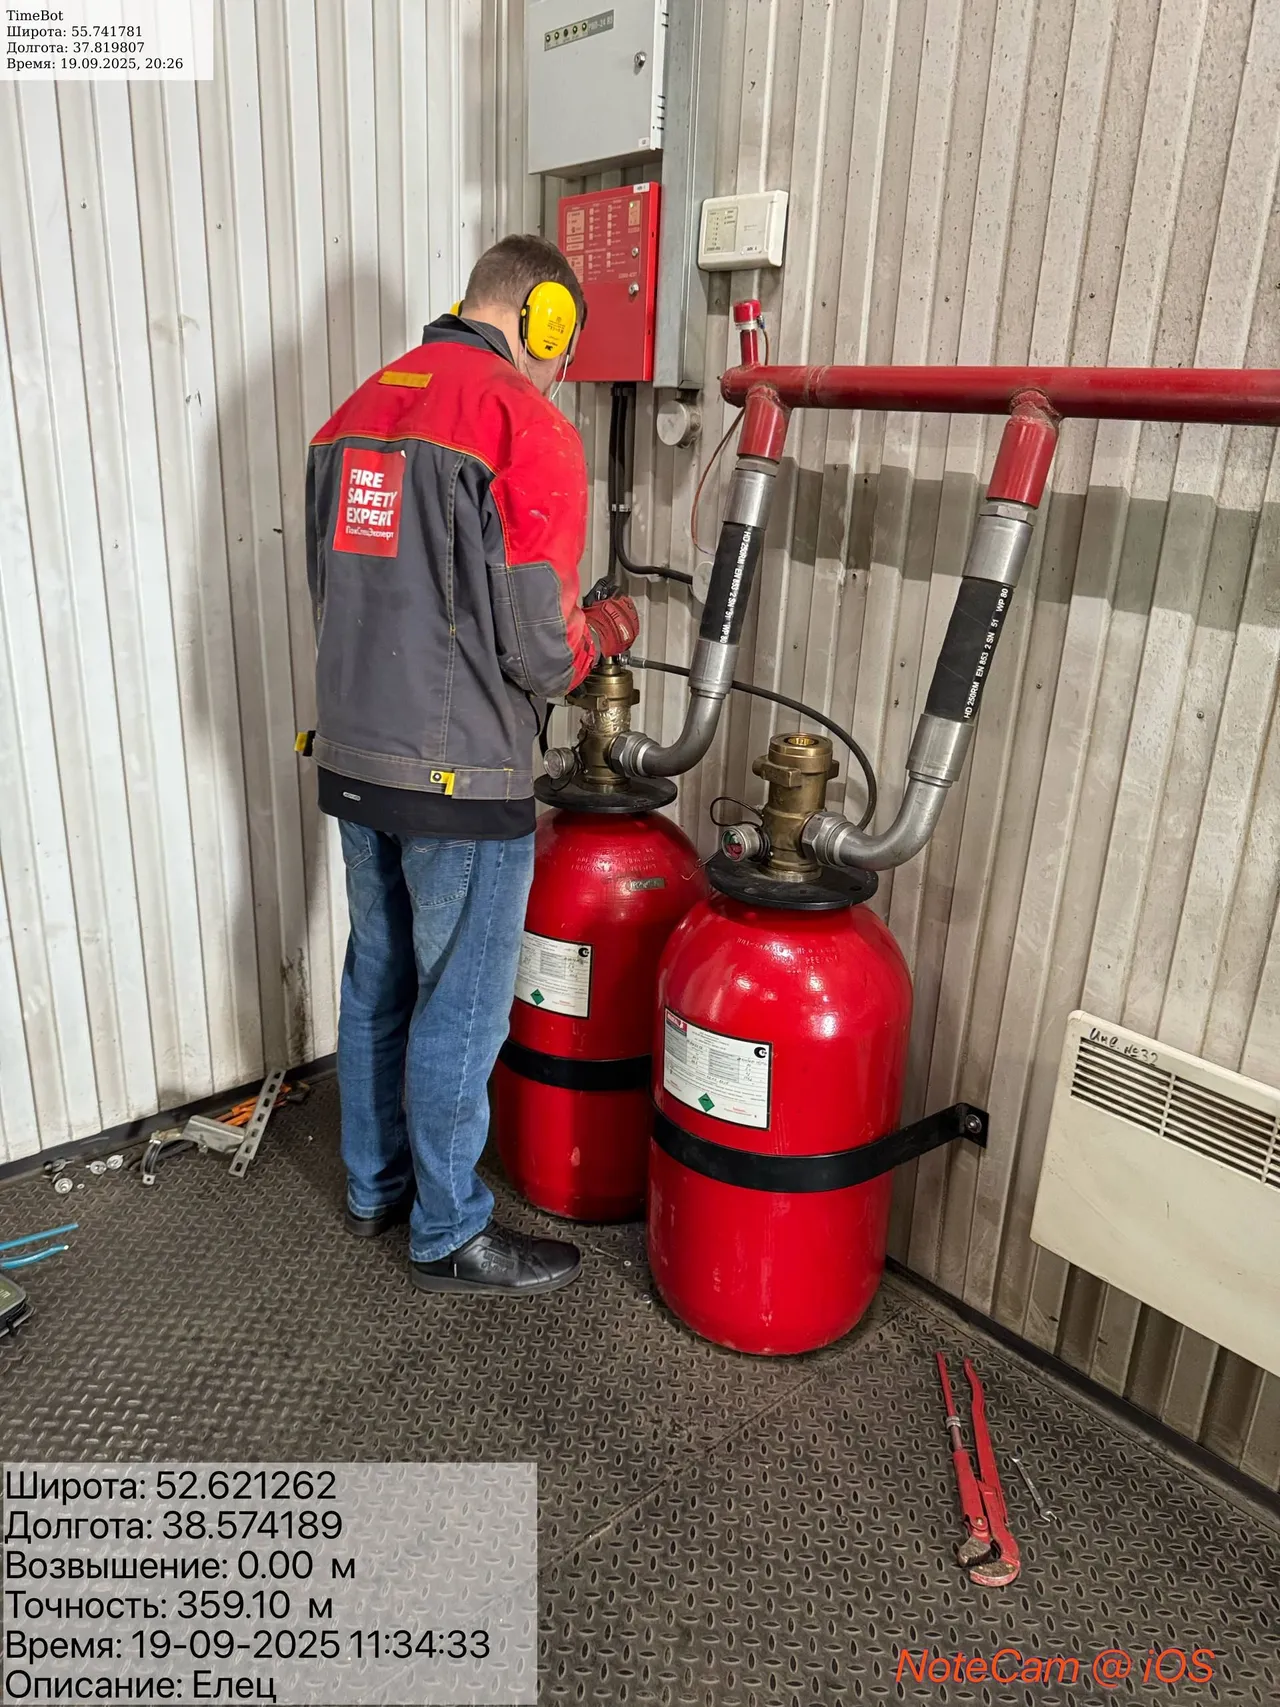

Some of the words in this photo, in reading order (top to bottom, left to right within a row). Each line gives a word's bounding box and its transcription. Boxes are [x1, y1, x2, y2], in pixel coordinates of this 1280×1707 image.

[349, 469, 385, 488] FIRE
[347, 488, 398, 508] SAFETY
[346, 507, 394, 526] EXPERT
[1000, 587, 1010, 599] 80
[995, 598, 1007, 613] WP
[990, 618, 1001, 629] 51
[986, 631, 997, 645] SN
[979, 652, 990, 667] 853
[975, 665, 986, 678] EN
[967, 681, 981, 707] 250RM
[963, 706, 974, 719] HD
